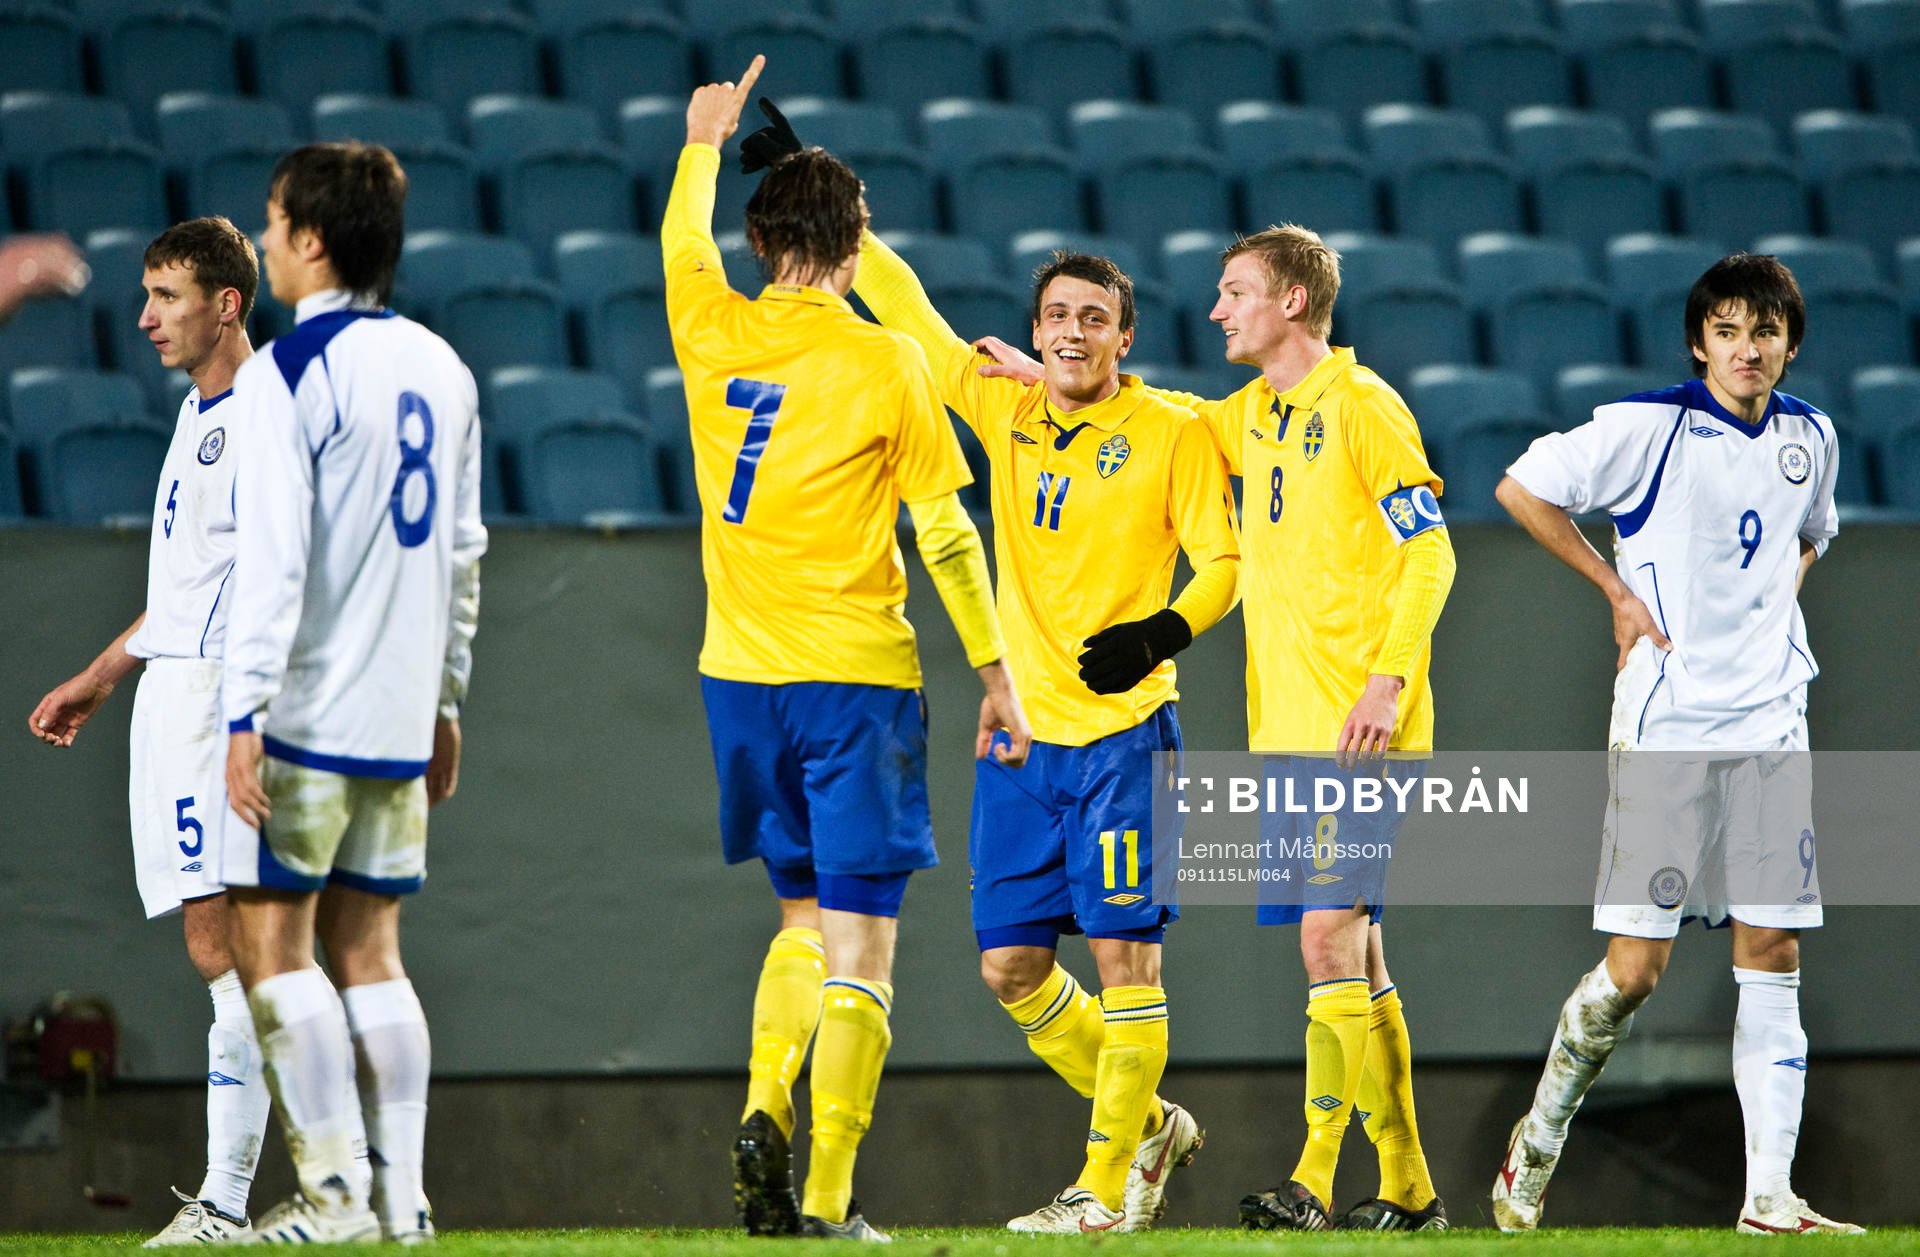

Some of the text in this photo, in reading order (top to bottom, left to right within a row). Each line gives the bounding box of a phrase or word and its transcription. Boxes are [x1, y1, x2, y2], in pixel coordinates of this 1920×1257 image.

[391, 390, 434, 548] 8
[723, 376, 787, 524] 7
[164, 479, 180, 539] 5
[1033, 471, 1071, 531] 11
[1270, 465, 1284, 523] 8
[1738, 509, 1762, 569] 9
[176, 795, 203, 858] 5
[1313, 813, 1338, 870] 8
[1098, 829, 1139, 889] 11
[1799, 828, 1816, 888] 9
